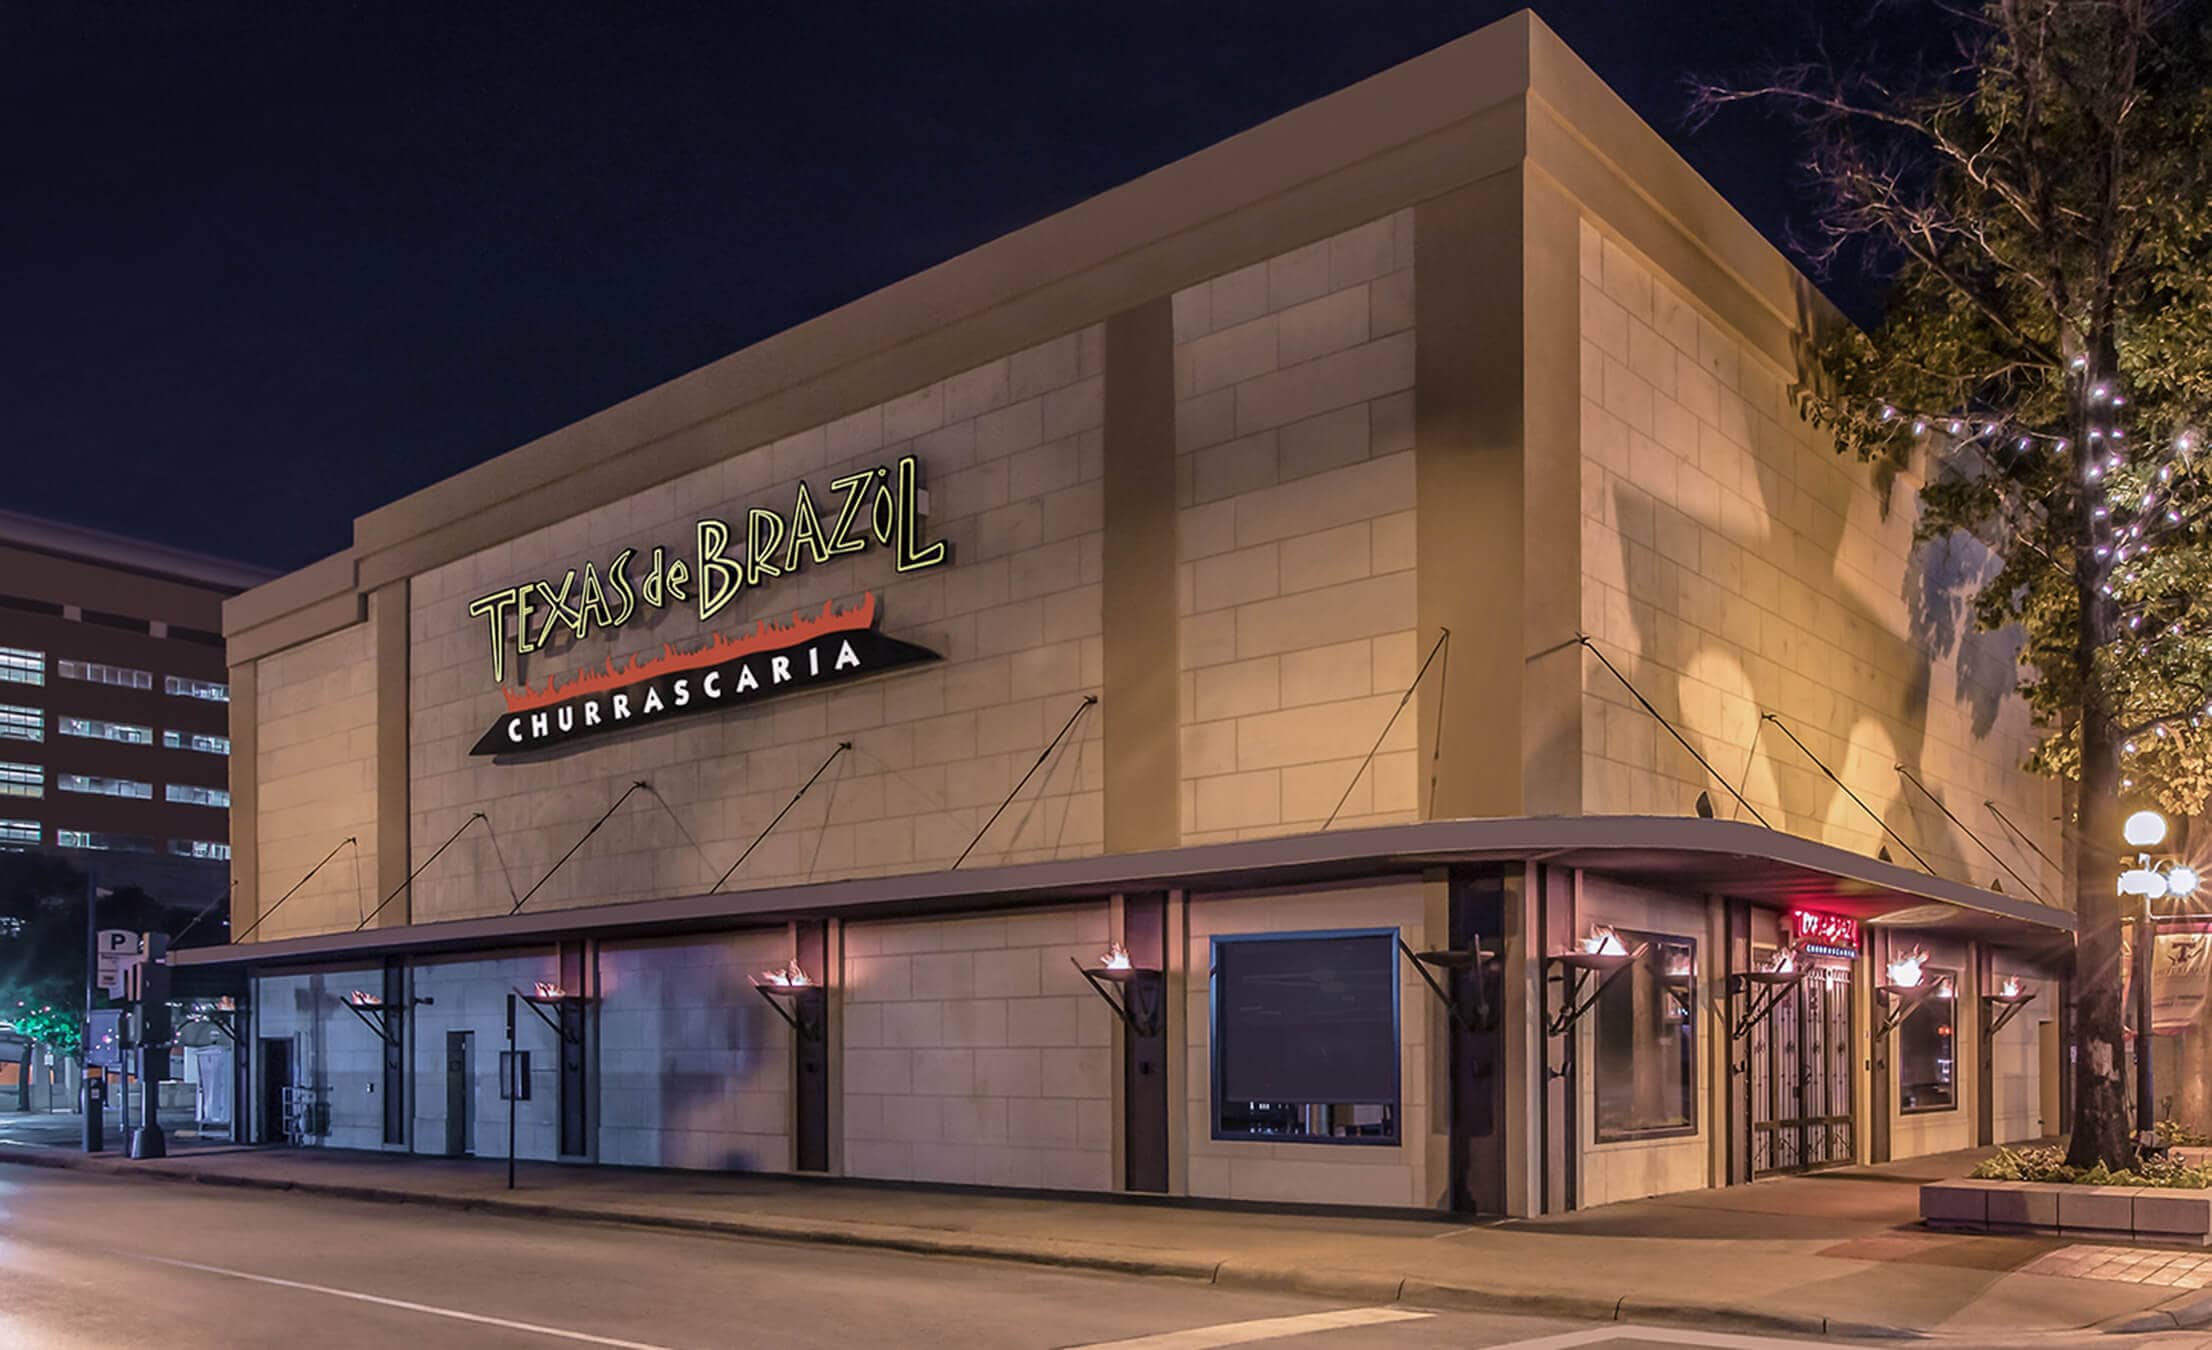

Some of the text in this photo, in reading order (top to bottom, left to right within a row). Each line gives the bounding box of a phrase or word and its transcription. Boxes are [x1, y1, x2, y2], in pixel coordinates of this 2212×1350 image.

[469, 547, 637, 683] TEXAS
[642, 547, 691, 608] de
[507, 639, 862, 743] CHURRASCARIA
[110, 933, 125, 950] P
